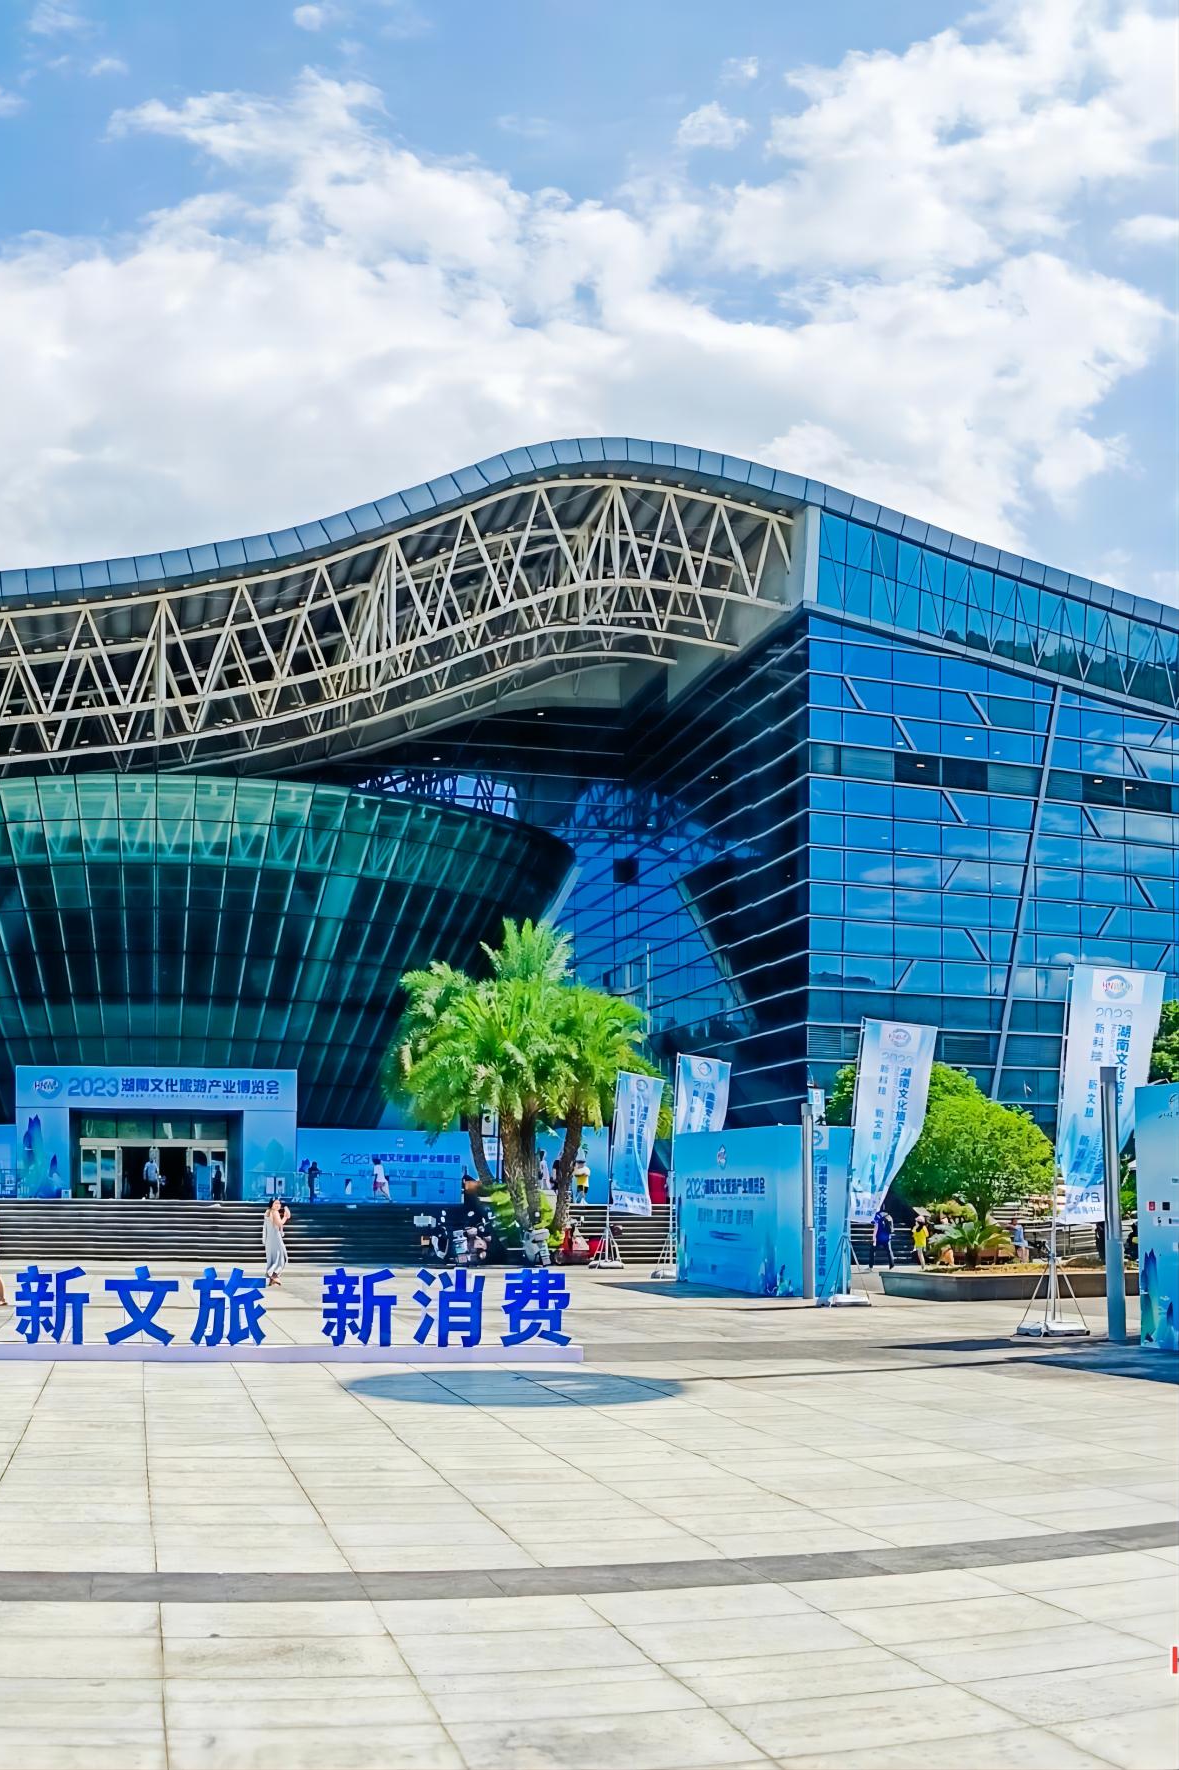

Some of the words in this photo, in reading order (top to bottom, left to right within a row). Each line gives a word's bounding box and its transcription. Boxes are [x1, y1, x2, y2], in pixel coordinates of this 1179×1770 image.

[15, 1266, 267, 1346] 新文旅
[322, 1267, 570, 1348] 新消费
